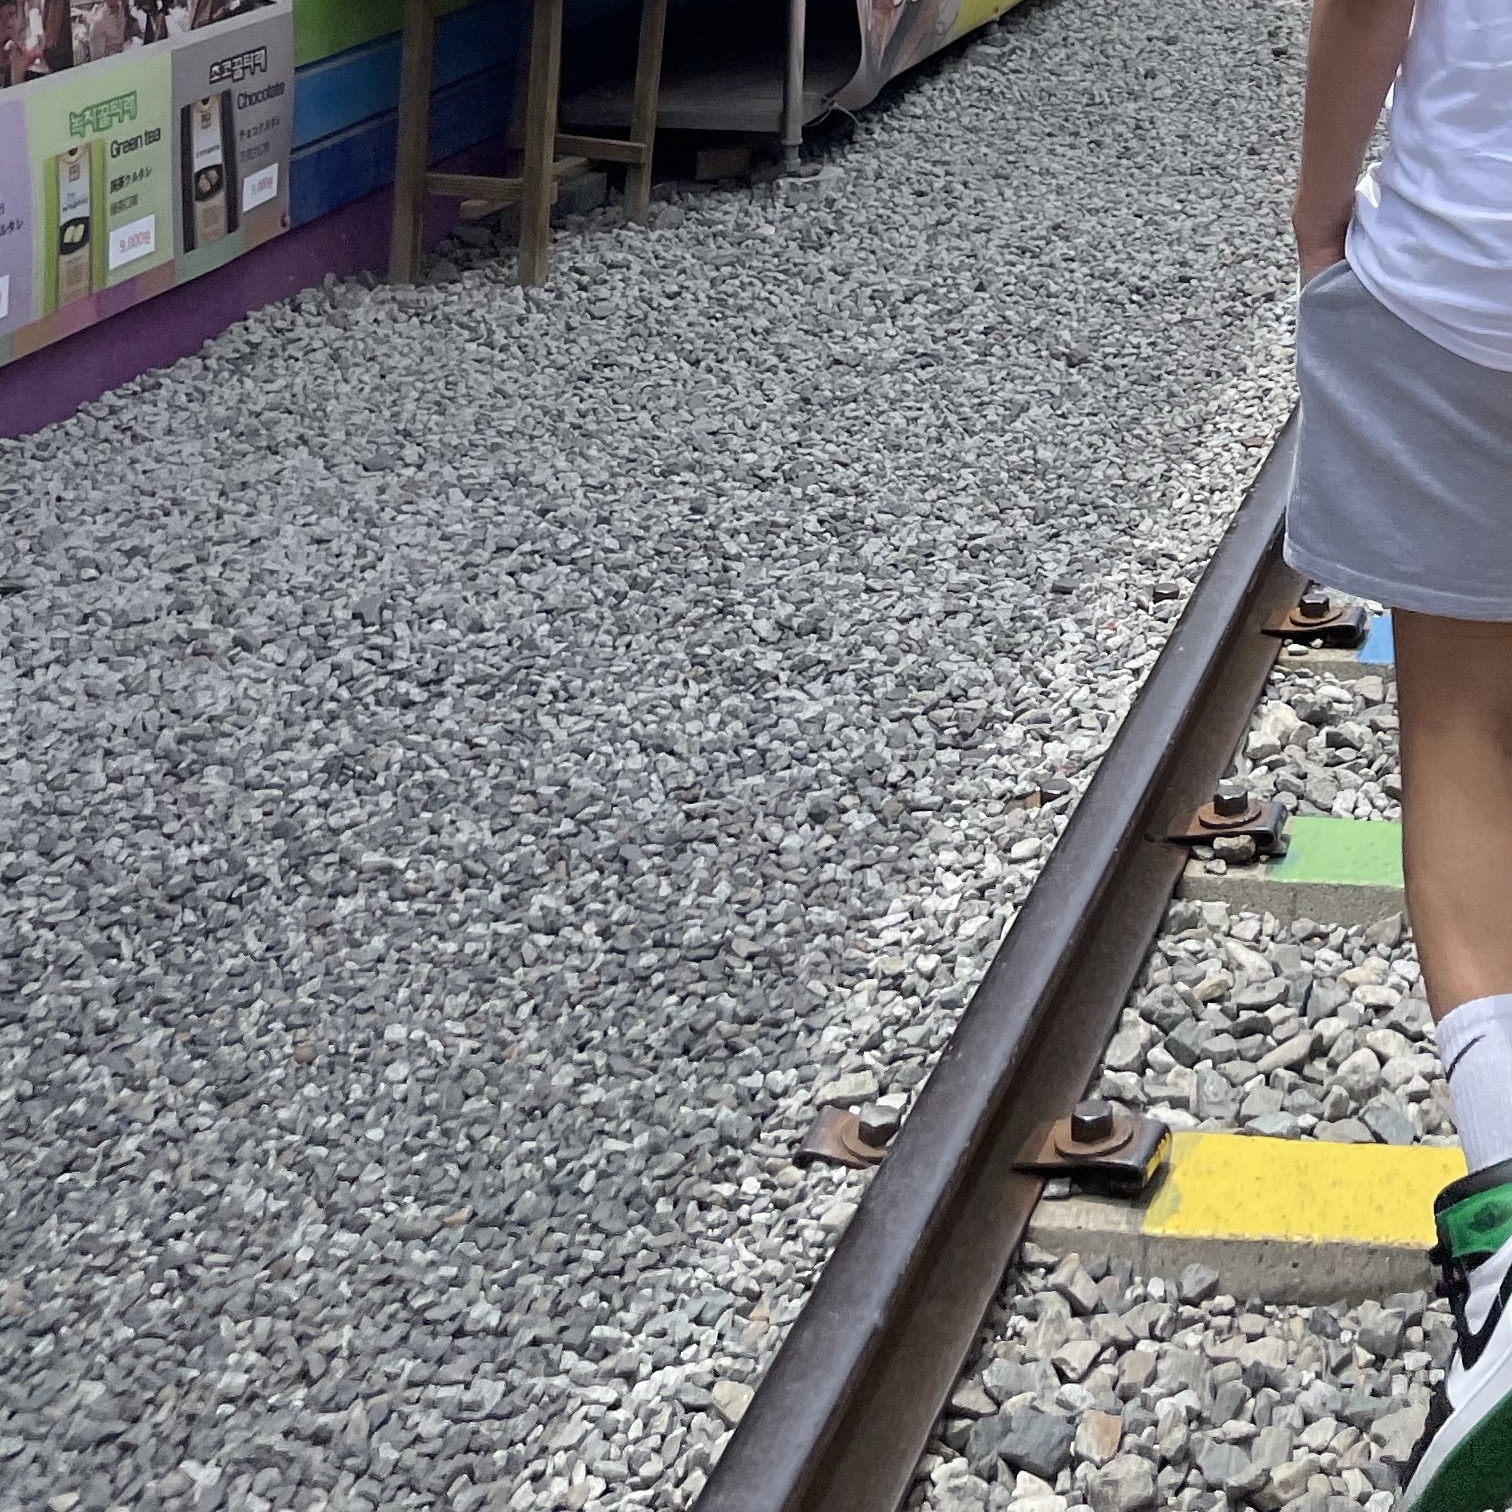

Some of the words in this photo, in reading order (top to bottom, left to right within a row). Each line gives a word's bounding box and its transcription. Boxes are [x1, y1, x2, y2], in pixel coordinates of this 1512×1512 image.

[209, 45, 268, 85] 초코꿀타래
[69, 90, 138, 138] 녹차꿀타래
[237, 82, 286, 110] Chocolate
[110, 133, 142, 159] Green
[143, 127, 161, 144] tea
